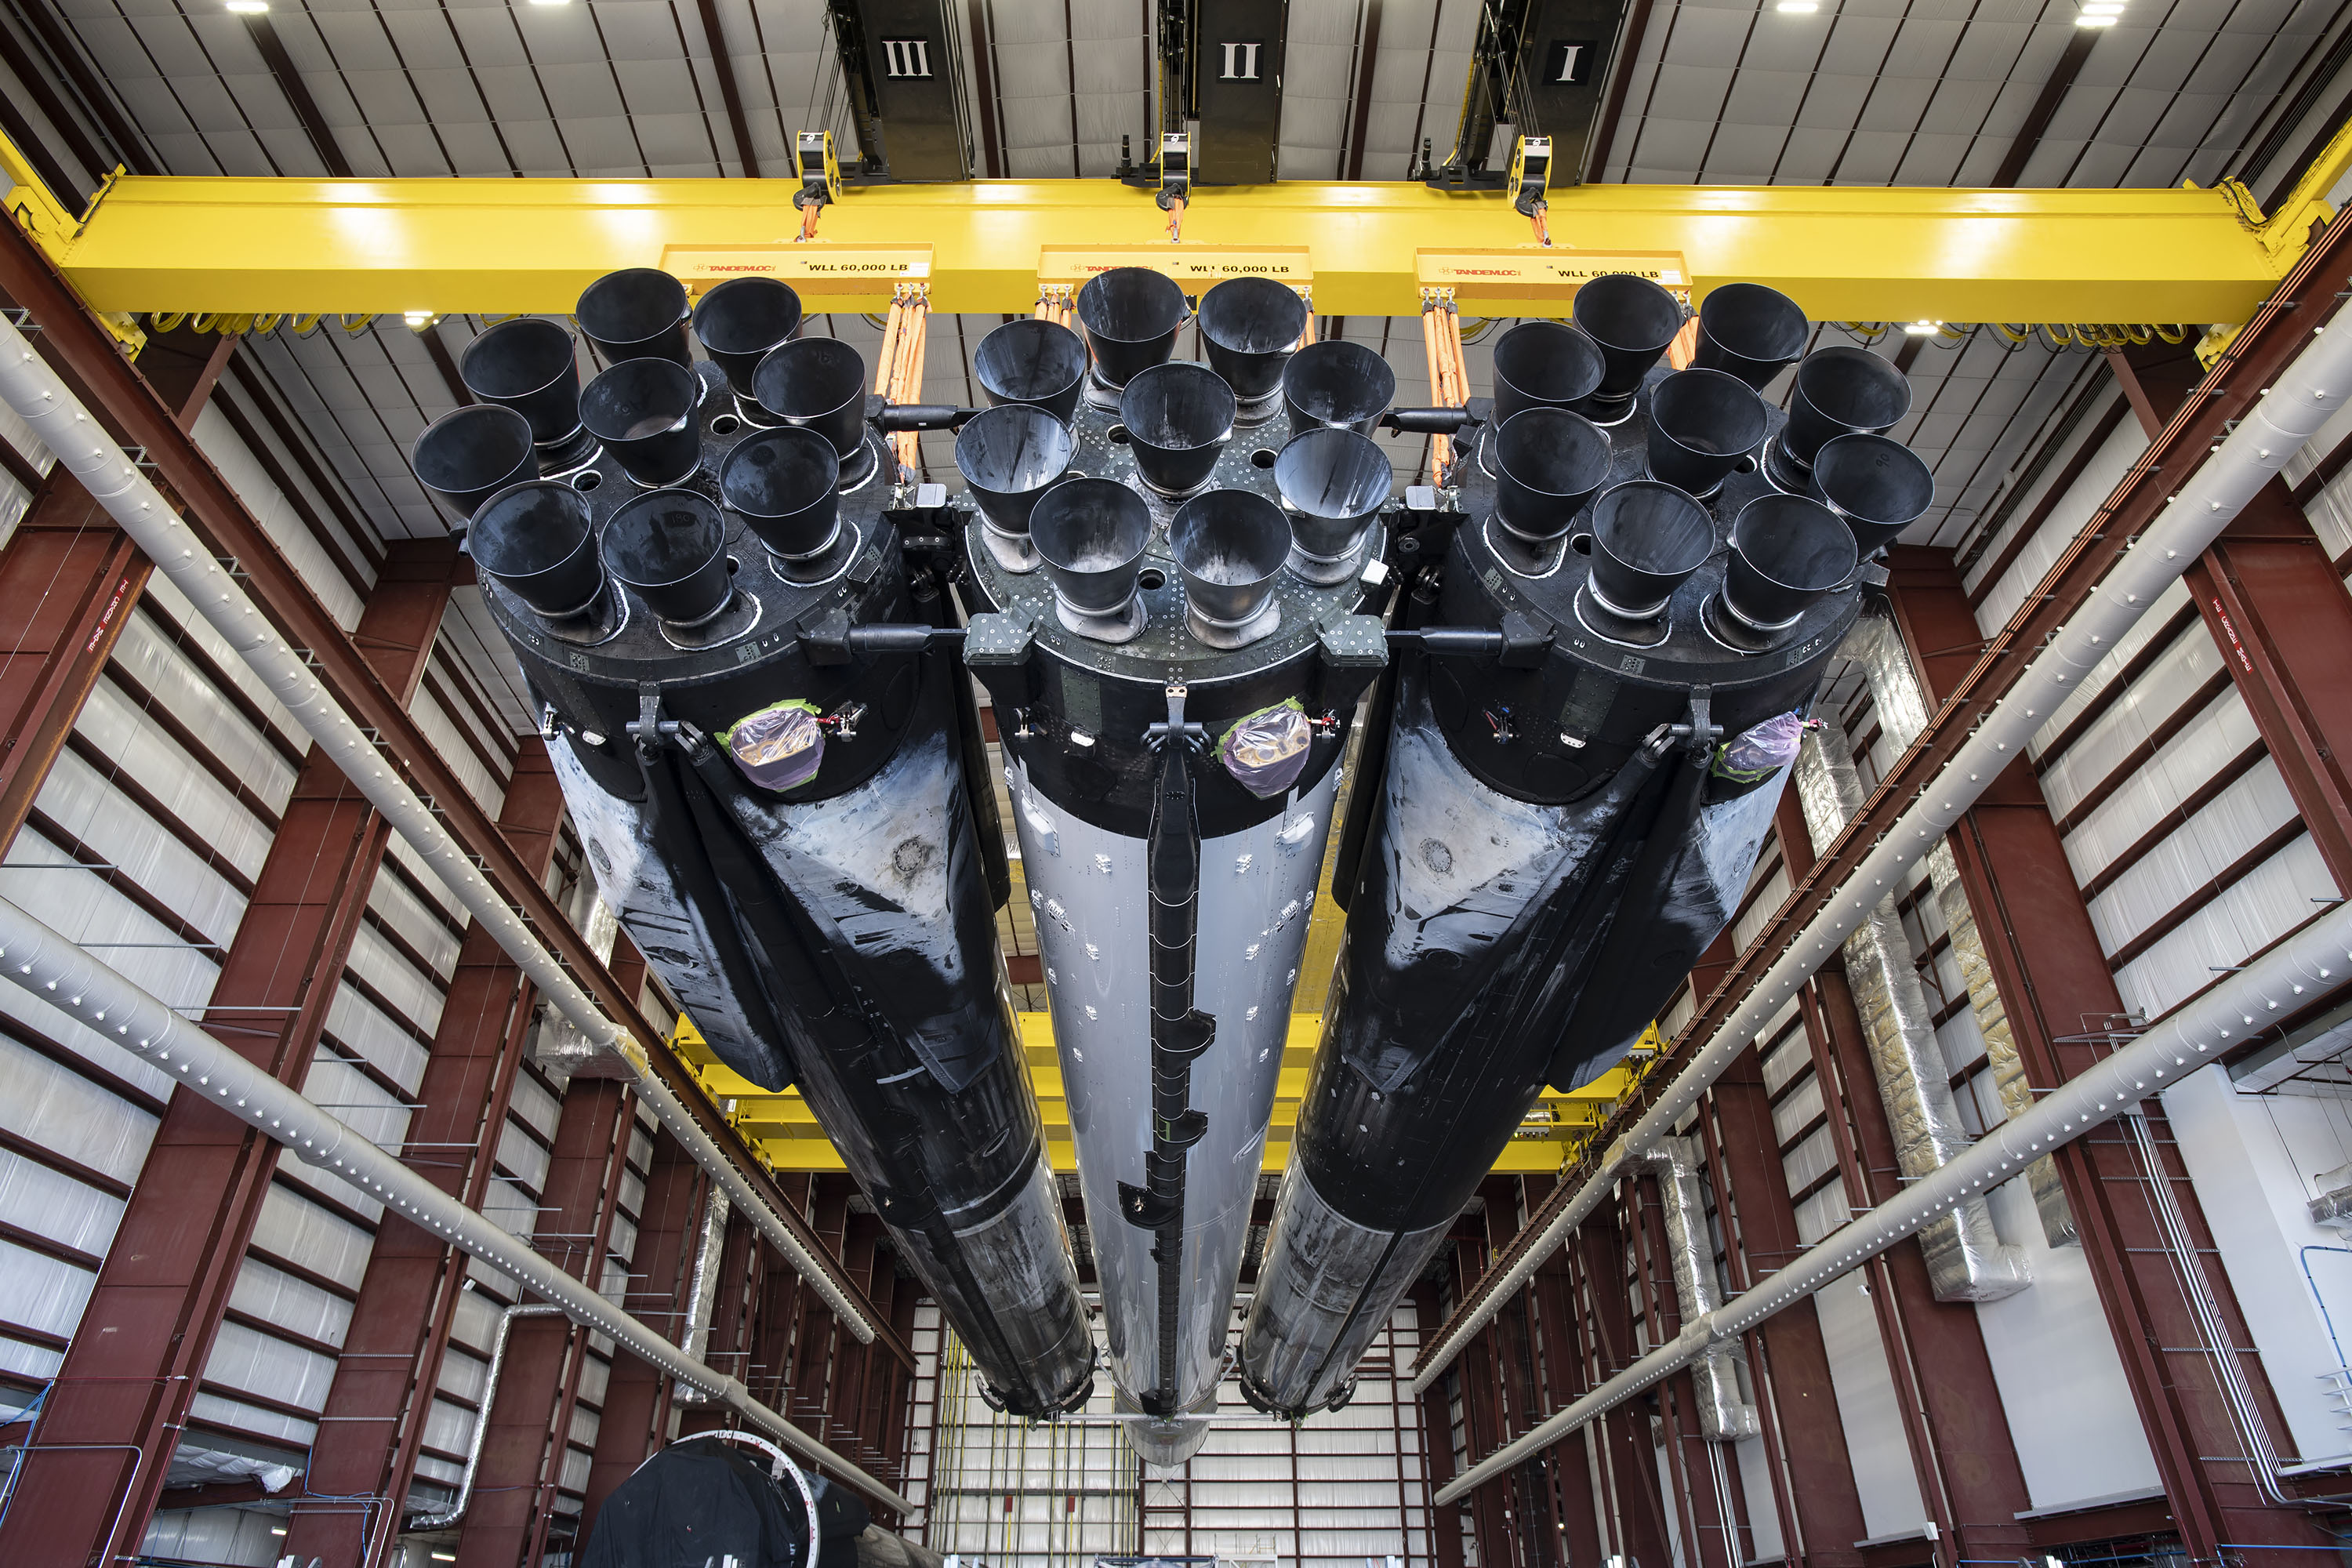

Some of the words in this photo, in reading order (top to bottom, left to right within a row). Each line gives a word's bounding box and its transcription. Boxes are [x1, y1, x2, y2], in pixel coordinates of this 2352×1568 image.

[882, 41, 932, 76] III
[1219, 43, 1261, 78] II
[1555, 45, 1583, 81] I
[103, 596, 120, 624] CRANE
[88, 626, 104, 652] MATE
[2221, 615, 2238, 644] CRANE
[2236, 647, 2252, 672] MATE
